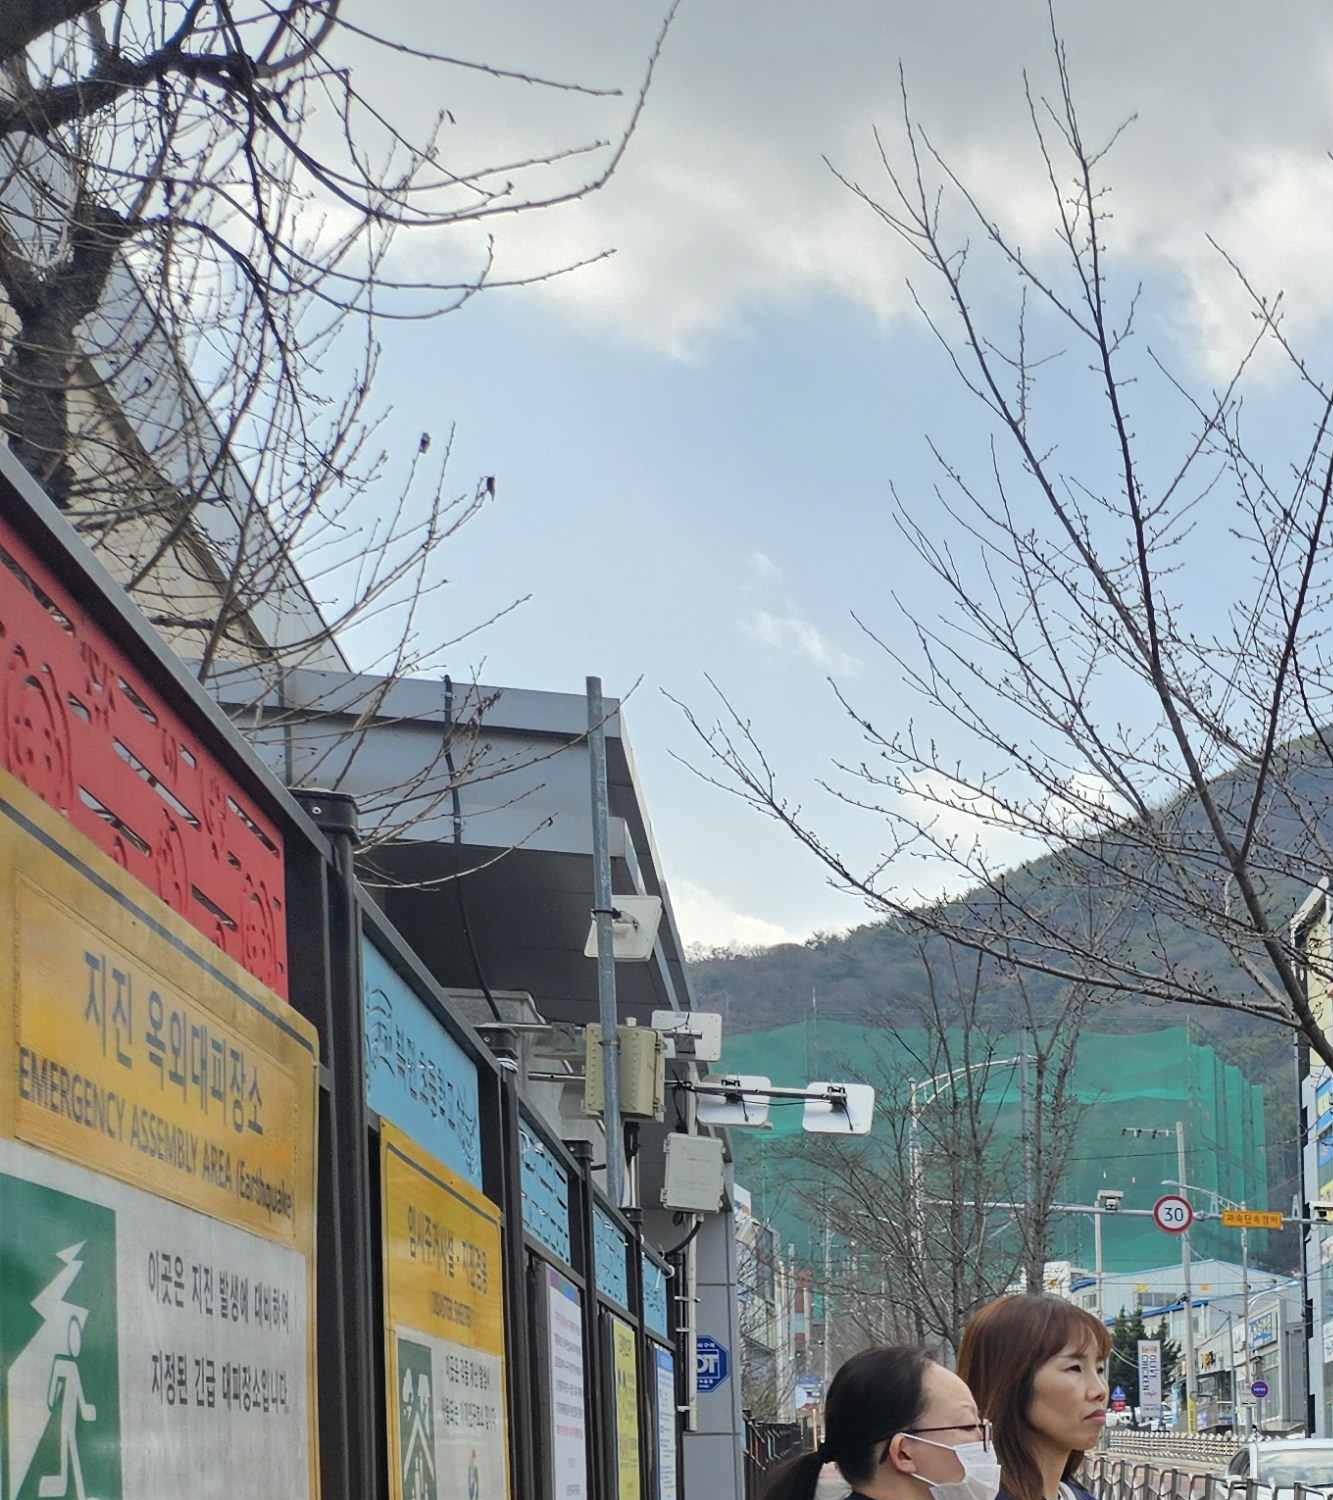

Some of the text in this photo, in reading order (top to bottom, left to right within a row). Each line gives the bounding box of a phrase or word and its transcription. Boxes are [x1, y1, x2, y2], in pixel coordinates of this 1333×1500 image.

[84, 951, 263, 1135] 지진 옥외대피장소
[19, 1046, 125, 1143] EMERGENCY
[131, 1104, 198, 1176] ASSEMBLY
[203, 1140, 232, 1191] AREA
[1164, 1207, 1184, 1221] 30
[1227, 1213, 1279, 1226] 과속단속장비
[148, 1250, 184, 1308] 이곳은
[192, 1263, 213, 1316] 지진
[220, 1271, 249, 1325] 발생에
[151, 1350, 188, 1406] 지정된
[194, 1357, 215, 1408] 긴급
[1141, 1354, 1150, 1391] CHICKEN
[1149, 1354, 1158, 1380] OLIVE
